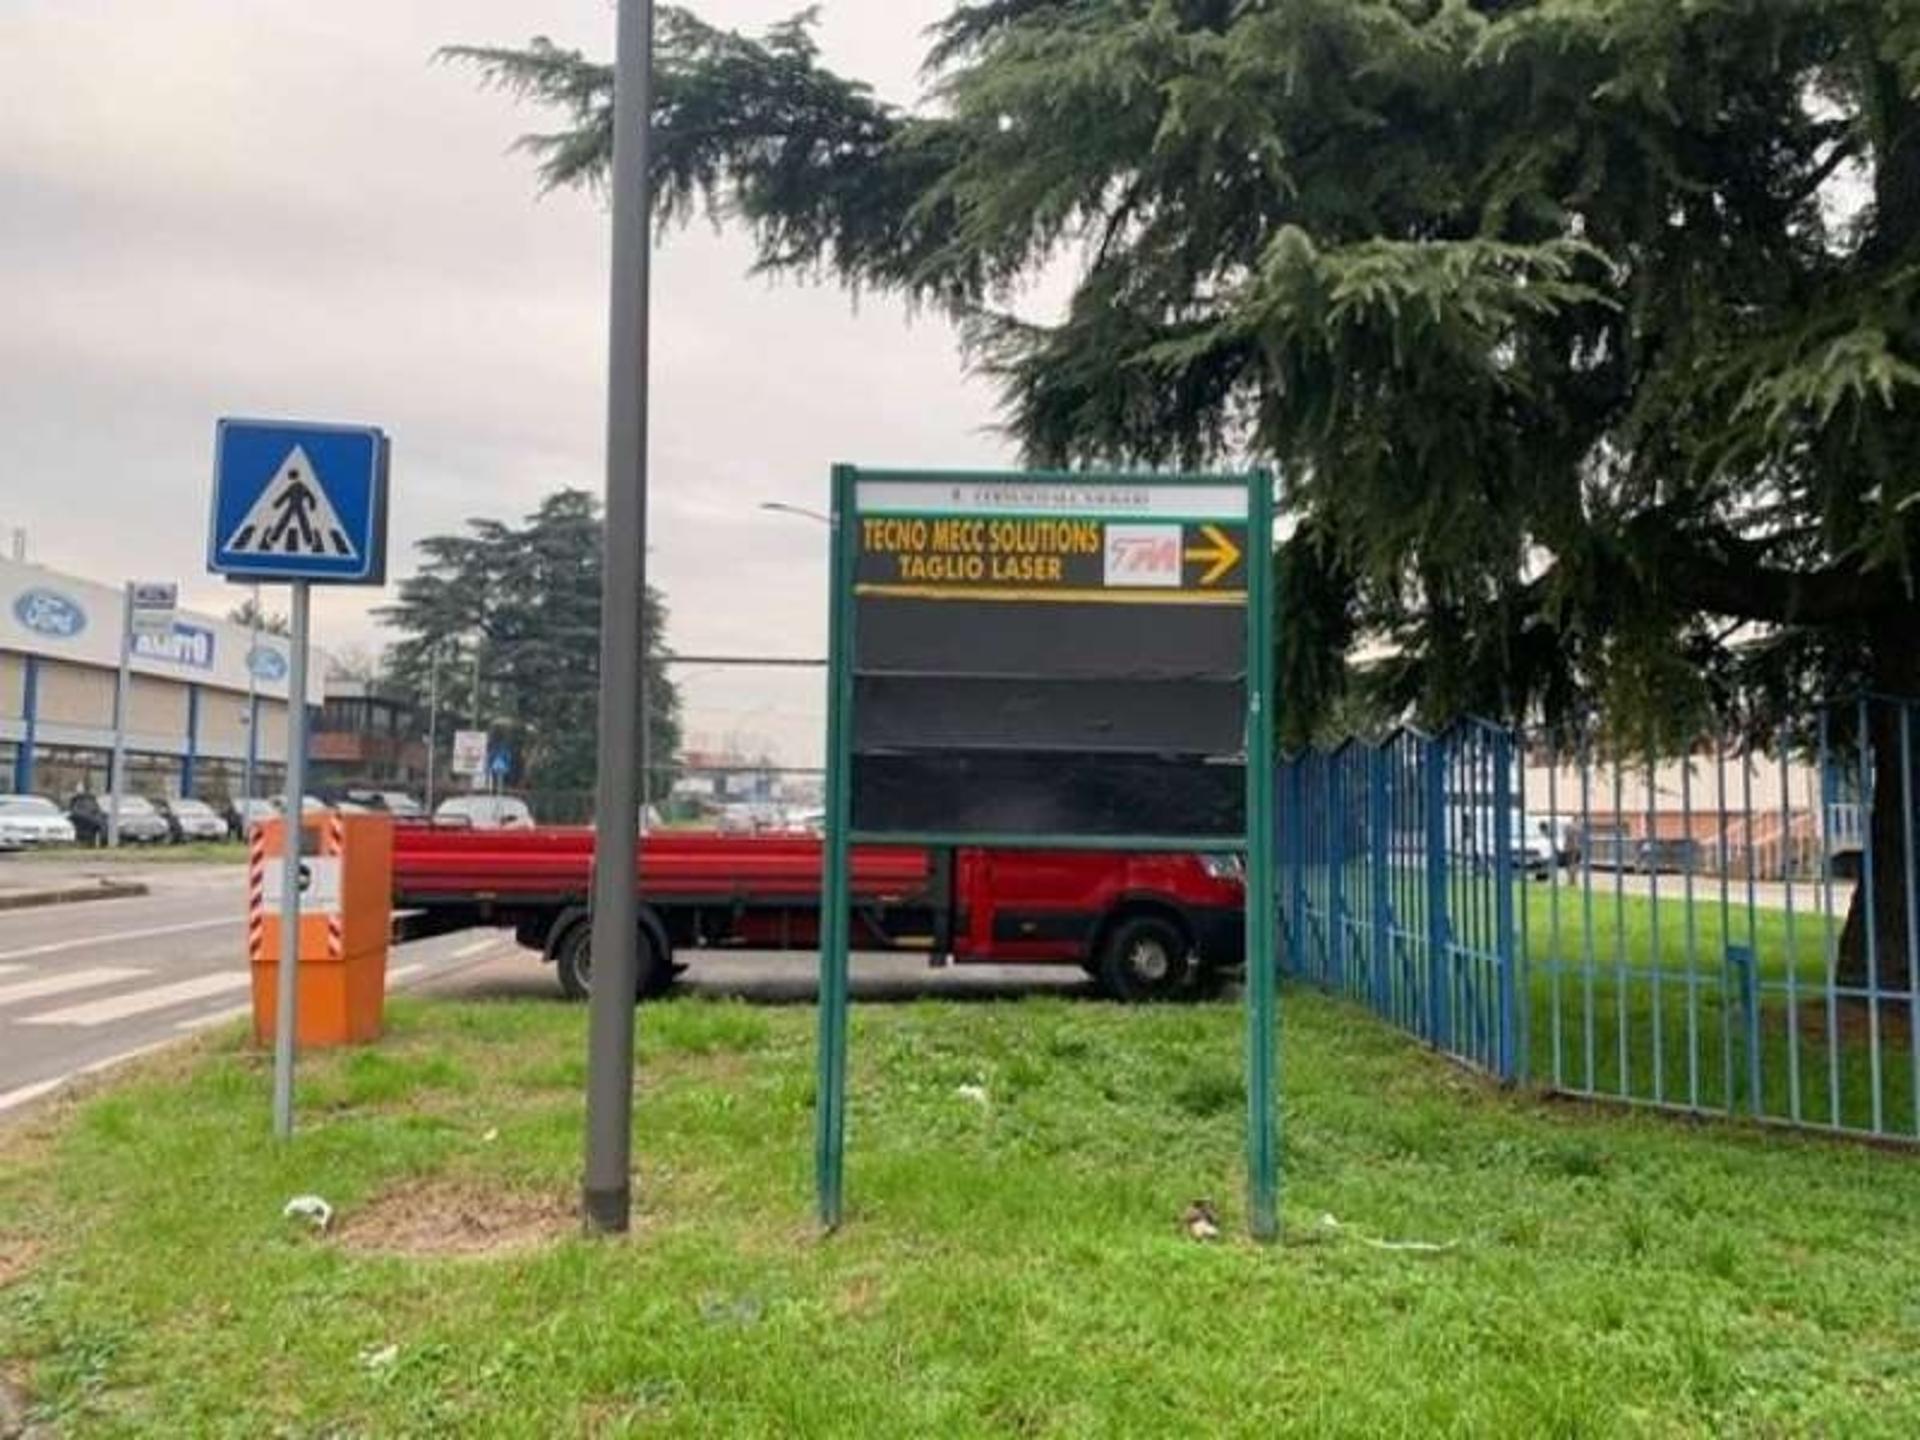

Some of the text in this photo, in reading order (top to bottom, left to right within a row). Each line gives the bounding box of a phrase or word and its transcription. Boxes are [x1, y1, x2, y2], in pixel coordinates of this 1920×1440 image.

[863, 519, 1100, 555] TECNO MECC SOLUTIONS
[899, 555, 1062, 580] TAGLIO LASER
[23, 593, 74, 634] Ford
